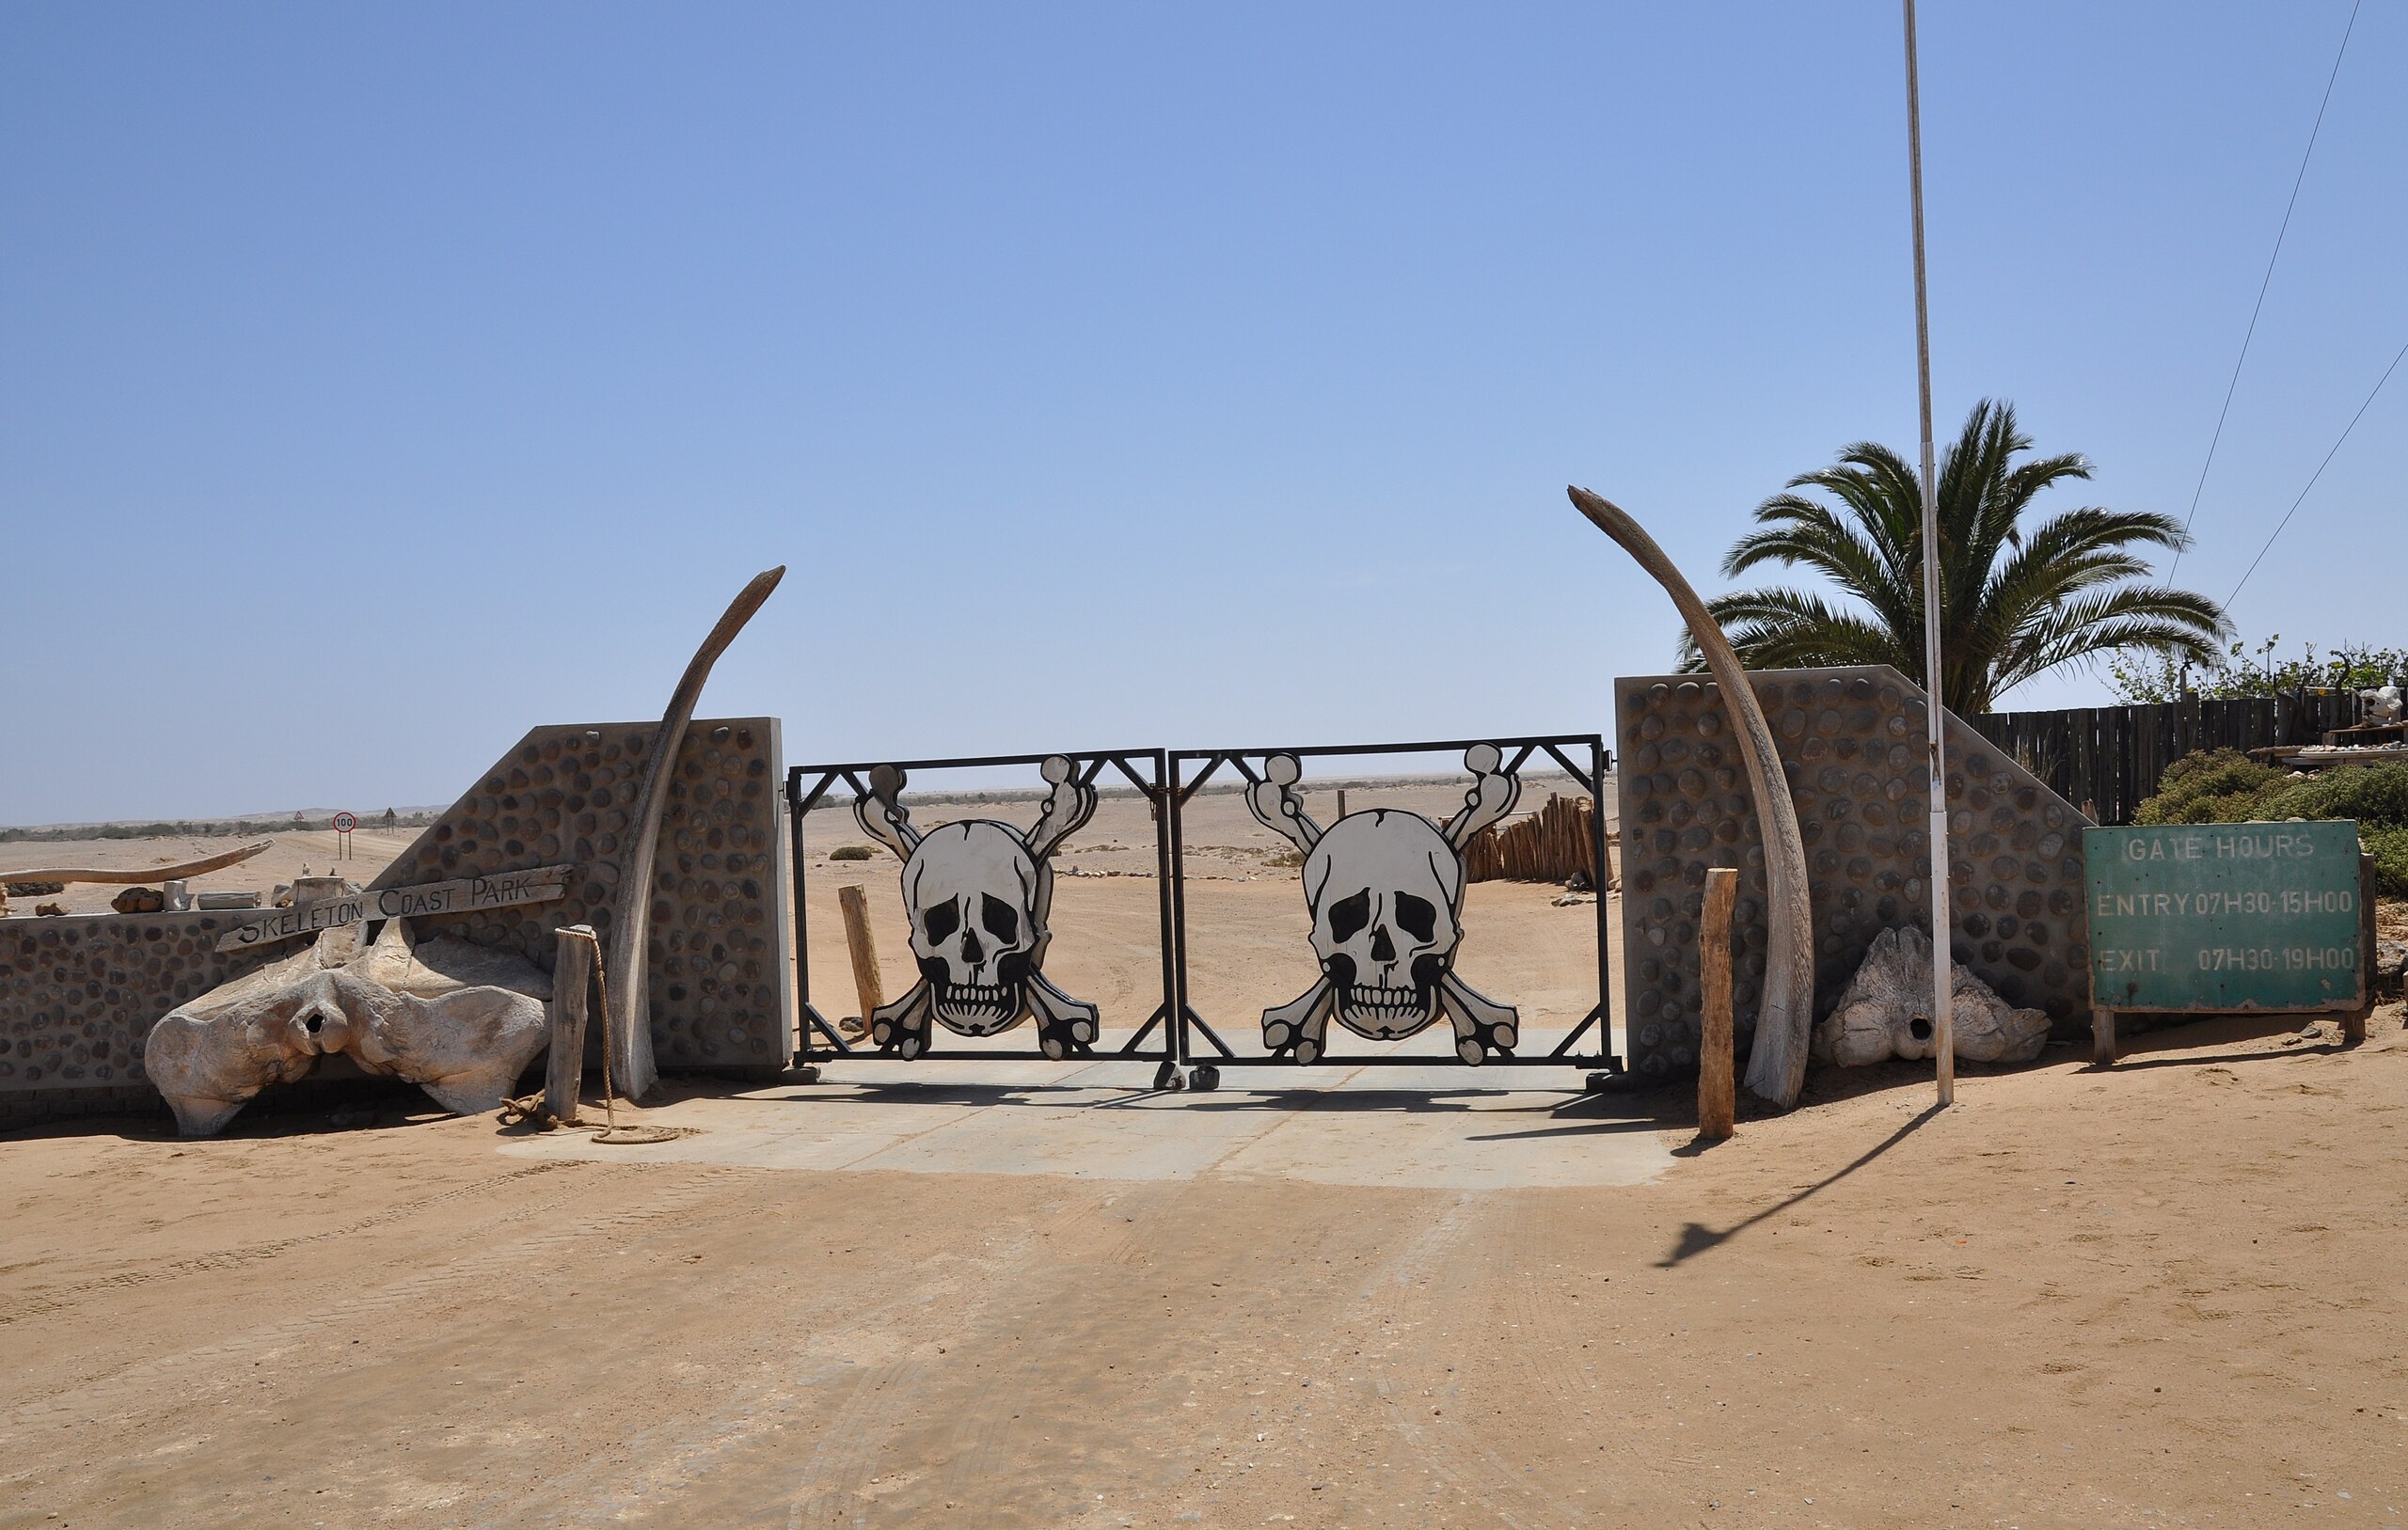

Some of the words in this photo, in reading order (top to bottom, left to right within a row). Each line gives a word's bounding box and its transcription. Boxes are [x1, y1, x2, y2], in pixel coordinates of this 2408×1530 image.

[337, 818, 353, 827] 100
[2128, 836, 2203, 860] GATE
[2216, 834, 2315, 859] HOURS
[238, 900, 364, 943] SKELETON
[378, 887, 456, 918] COAST
[471, 875, 532, 906] PARK
[2097, 892, 2190, 917] ENTRY
[2099, 949, 2161, 971] EXIT
